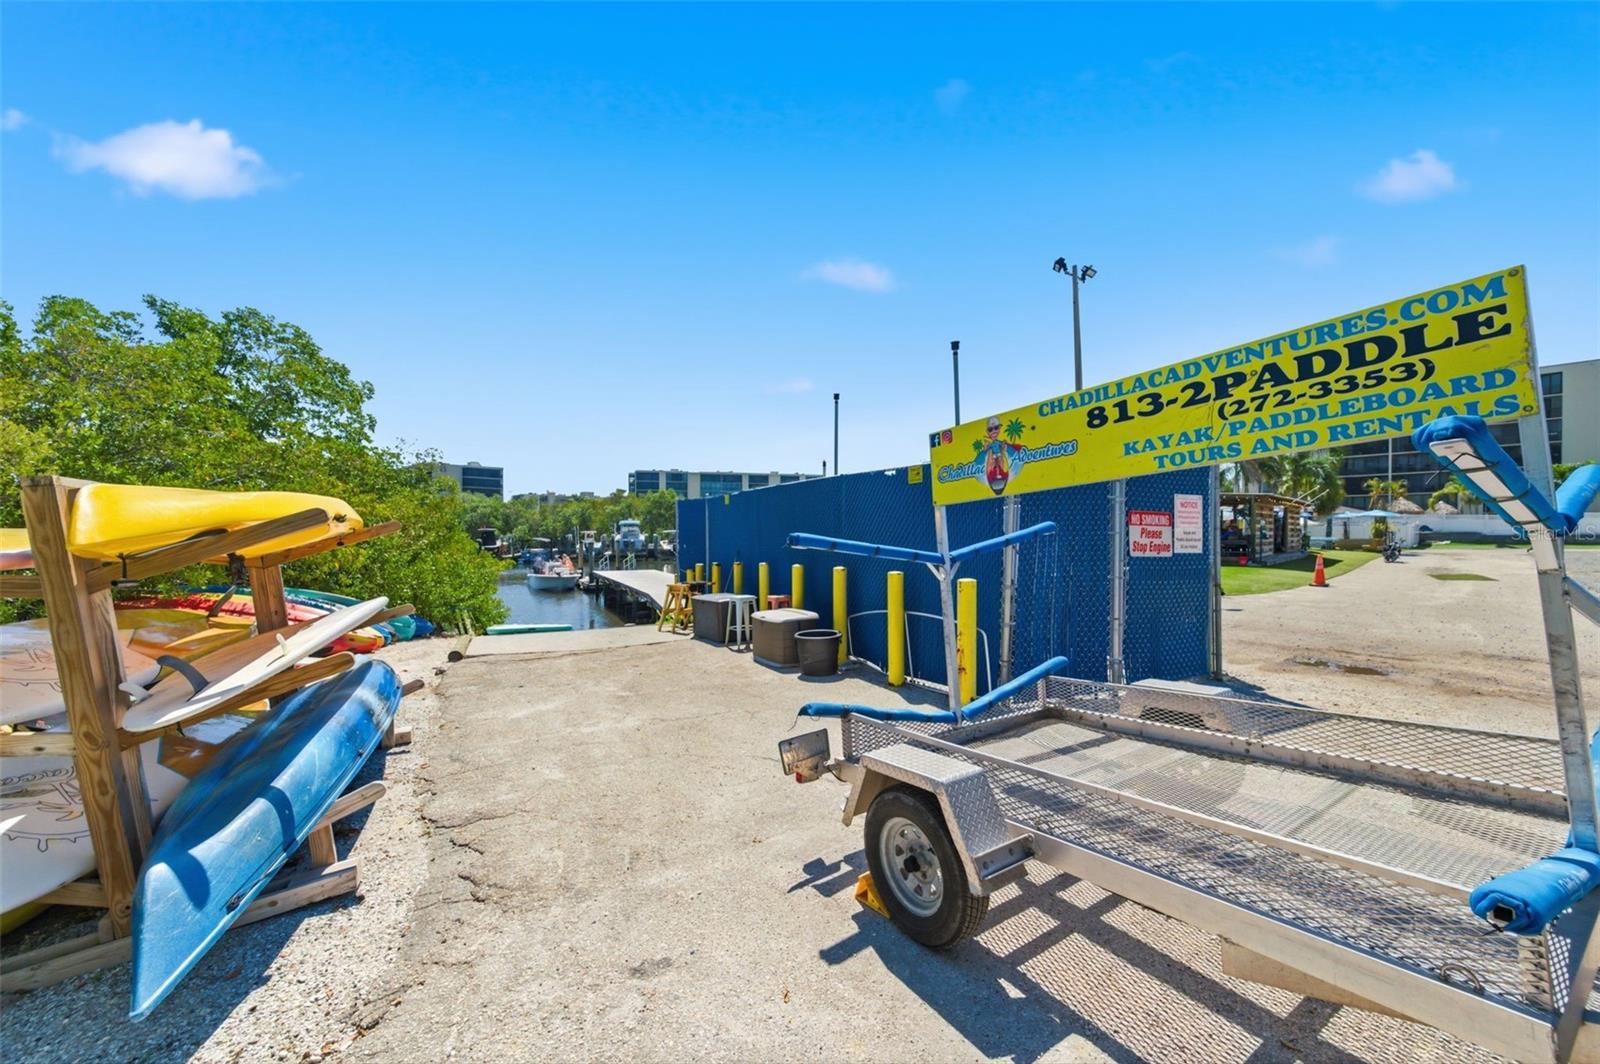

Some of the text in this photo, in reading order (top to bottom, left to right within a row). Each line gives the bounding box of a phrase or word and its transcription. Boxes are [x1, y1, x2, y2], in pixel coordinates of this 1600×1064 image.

[1038, 275, 1509, 417] CHADILLACADVENTURES.COM
[1086, 303, 1512, 429] 813-2PADDLE
[1217, 358, 1435, 420] (272-3353)
[1011, 440, 1077, 464] Adventures
[1153, 441, 1242, 469] TOURS
[1250, 429, 1318, 455] AND
[1131, 512, 1140, 525] NO
[1140, 527, 1163, 540] Please
[1132, 541, 1171, 555] Stop Engine
